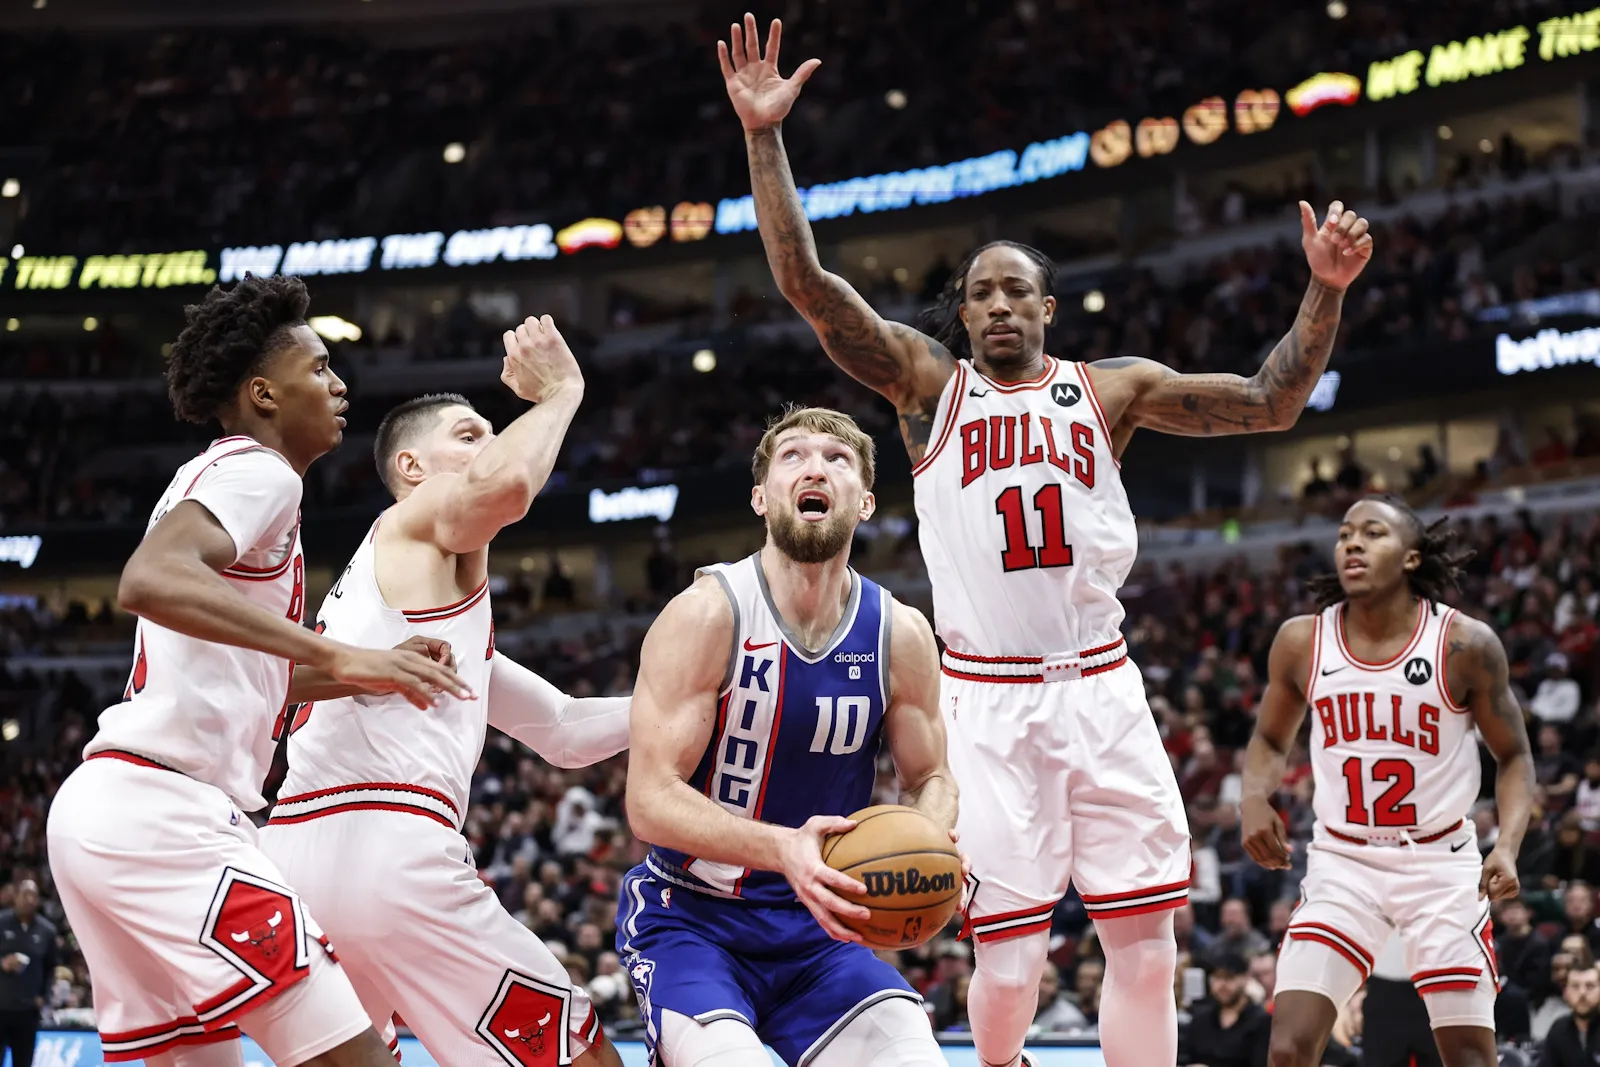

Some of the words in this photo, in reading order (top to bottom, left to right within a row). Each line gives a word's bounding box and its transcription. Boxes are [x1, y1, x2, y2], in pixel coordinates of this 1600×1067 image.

[1367, 51, 1424, 100] WE
[1426, 27, 1529, 86] MAKE
[1538, 9, 1600, 61] THE
[14, 256, 77, 289] THE
[78, 250, 216, 289] PRETZEL.
[219, 245, 283, 283] YOU
[280, 237, 377, 276] MAKE
[381, 232, 445, 269] THE
[960, 412, 1095, 489] BULLS
[588, 484, 679, 523] betway
[995, 483, 1074, 573] 11
[834, 651, 875, 665] dialpad
[809, 695, 871, 756] 10
[1315, 692, 1440, 757] BULLS
[1342, 756, 1417, 827] 12
[861, 867, 956, 898] Wilson
